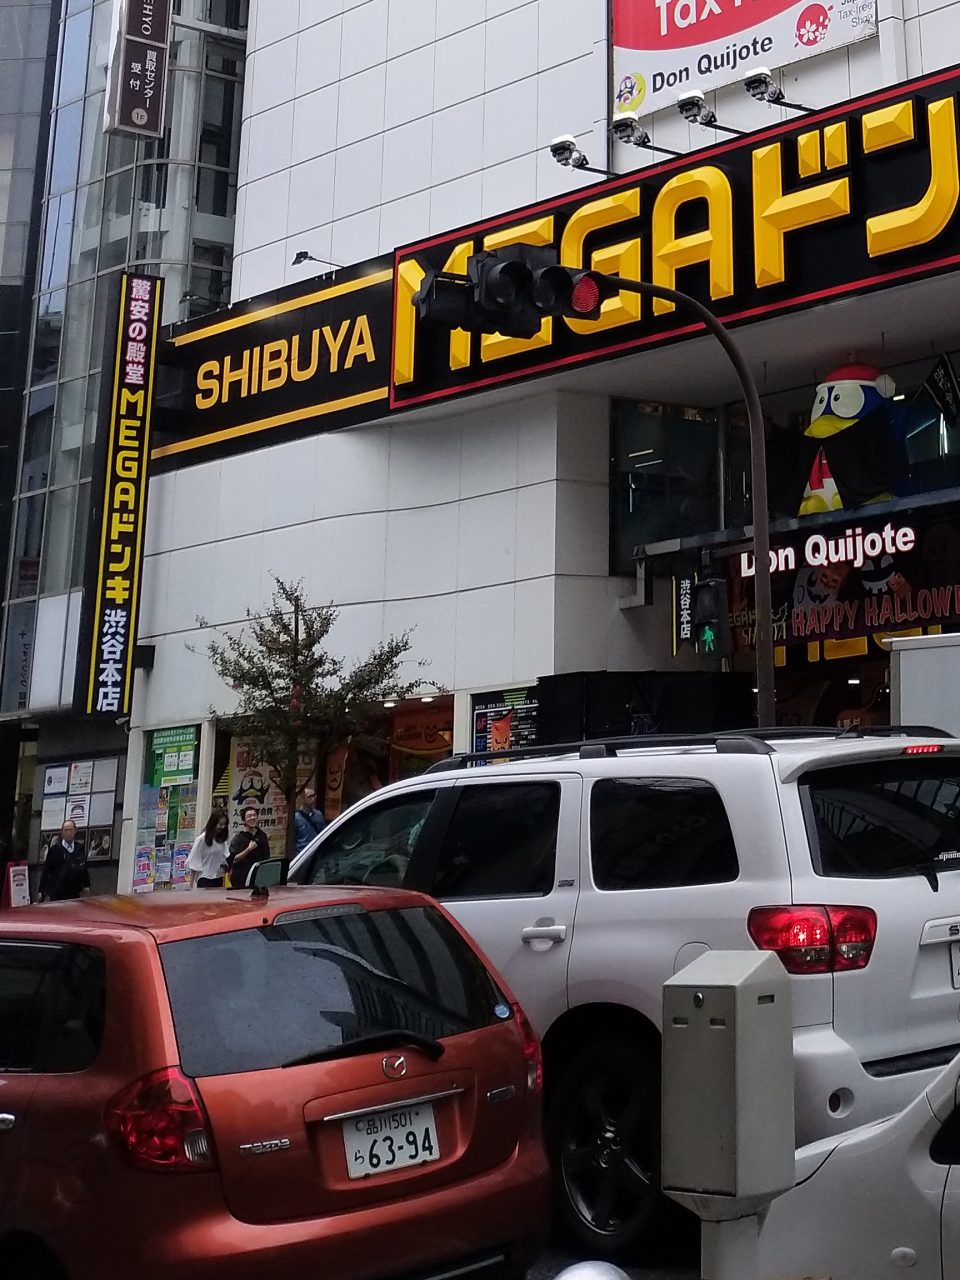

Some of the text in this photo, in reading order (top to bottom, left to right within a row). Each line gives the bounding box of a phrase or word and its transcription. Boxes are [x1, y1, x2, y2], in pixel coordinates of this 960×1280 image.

[129, 62, 142, 91] 受付
[652, 35, 773, 93] Don Quijote
[124, 278, 151, 386] 驚安の殿堂
[195, 314, 377, 410] SHIBUYA
[105, 388, 145, 605] MEGAドンキ
[805, 522, 915, 568] Quijote
[680, 579, 691, 639] 渋谷本店
[791, 599, 859, 637] HAPPY
[96, 608, 127, 713] 渋谷本店
[354, 1127, 433, 1168] ら 63-94
[366, 1111, 413, 1135] 品川501
